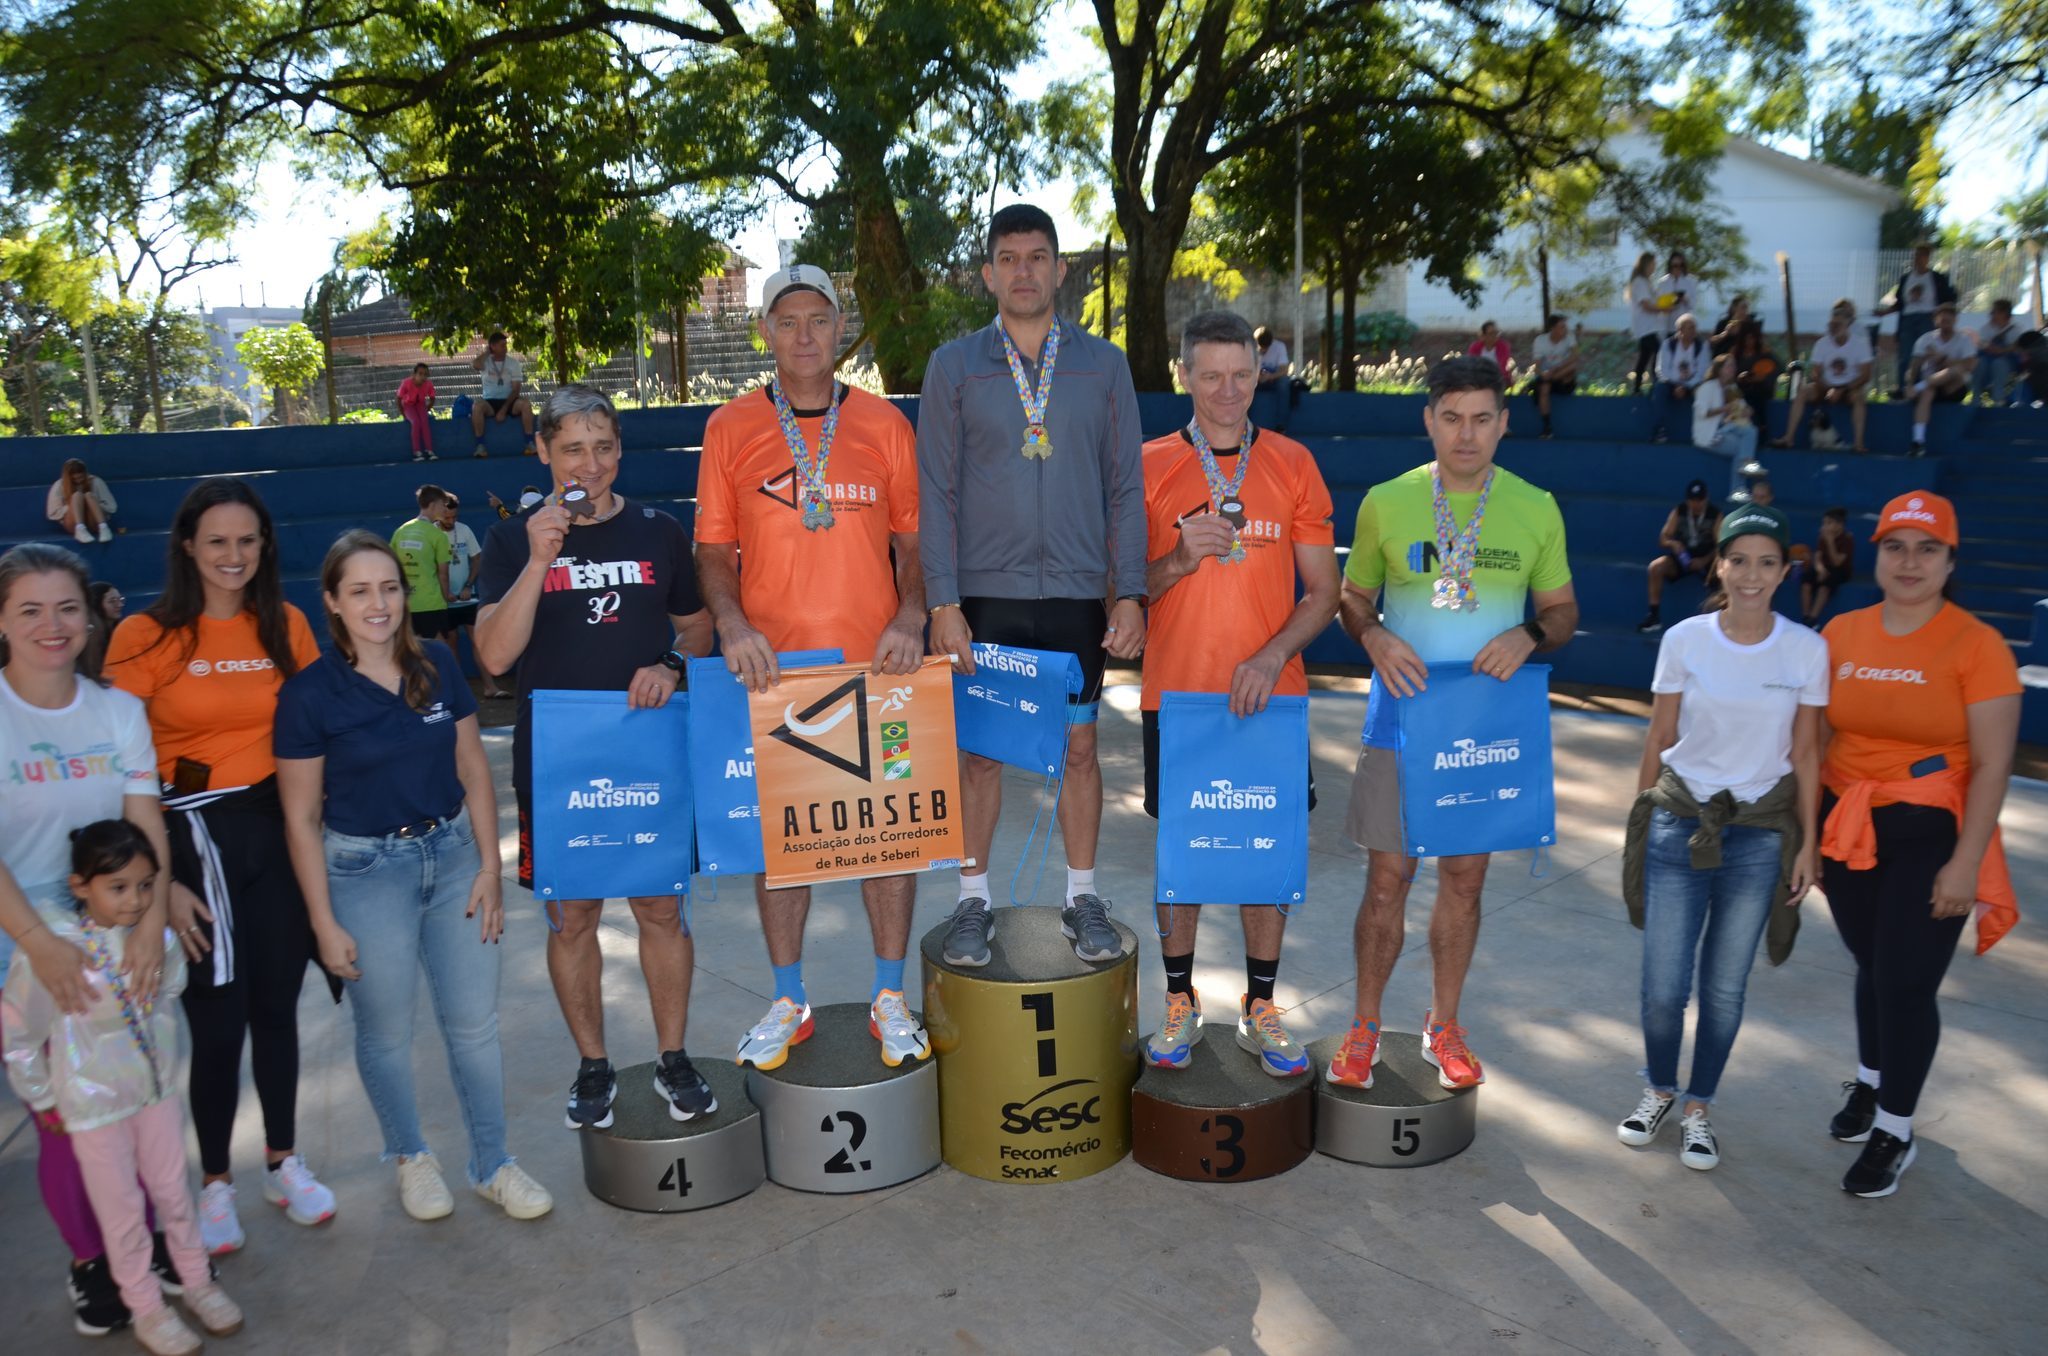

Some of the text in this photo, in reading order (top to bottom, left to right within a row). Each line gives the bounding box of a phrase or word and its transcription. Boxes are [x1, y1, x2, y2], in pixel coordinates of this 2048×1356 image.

[799, 484, 876, 502] AORSEB
[544, 560, 656, 593] MESTRE
[587, 591, 621, 624] 30
[215, 658, 275, 673] CRESO
[974, 650, 1037, 678] utismo
[1855, 666, 1928, 685] CRESOL
[1434, 746, 1521, 771] Autismo
[568, 790, 660, 810] Autismo
[784, 789, 948, 838] ACORSEB
[1190, 790, 1277, 810] Autismo
[783, 826, 948, 854] Associação dos Corredores
[815, 847, 920, 870] de Rua de Seberi
[1021, 992, 1057, 1078] 1
[1000, 1079, 1100, 1135] Sesc
[821, 1110, 872, 1174] 2
[1000, 1137, 1101, 1160] Fecomércio
[1200, 1114, 1247, 1178] 3
[1391, 1118, 1421, 1157] 5
[657, 1157, 693, 1197] 4
[1001, 1164, 1058, 1179] Senac
